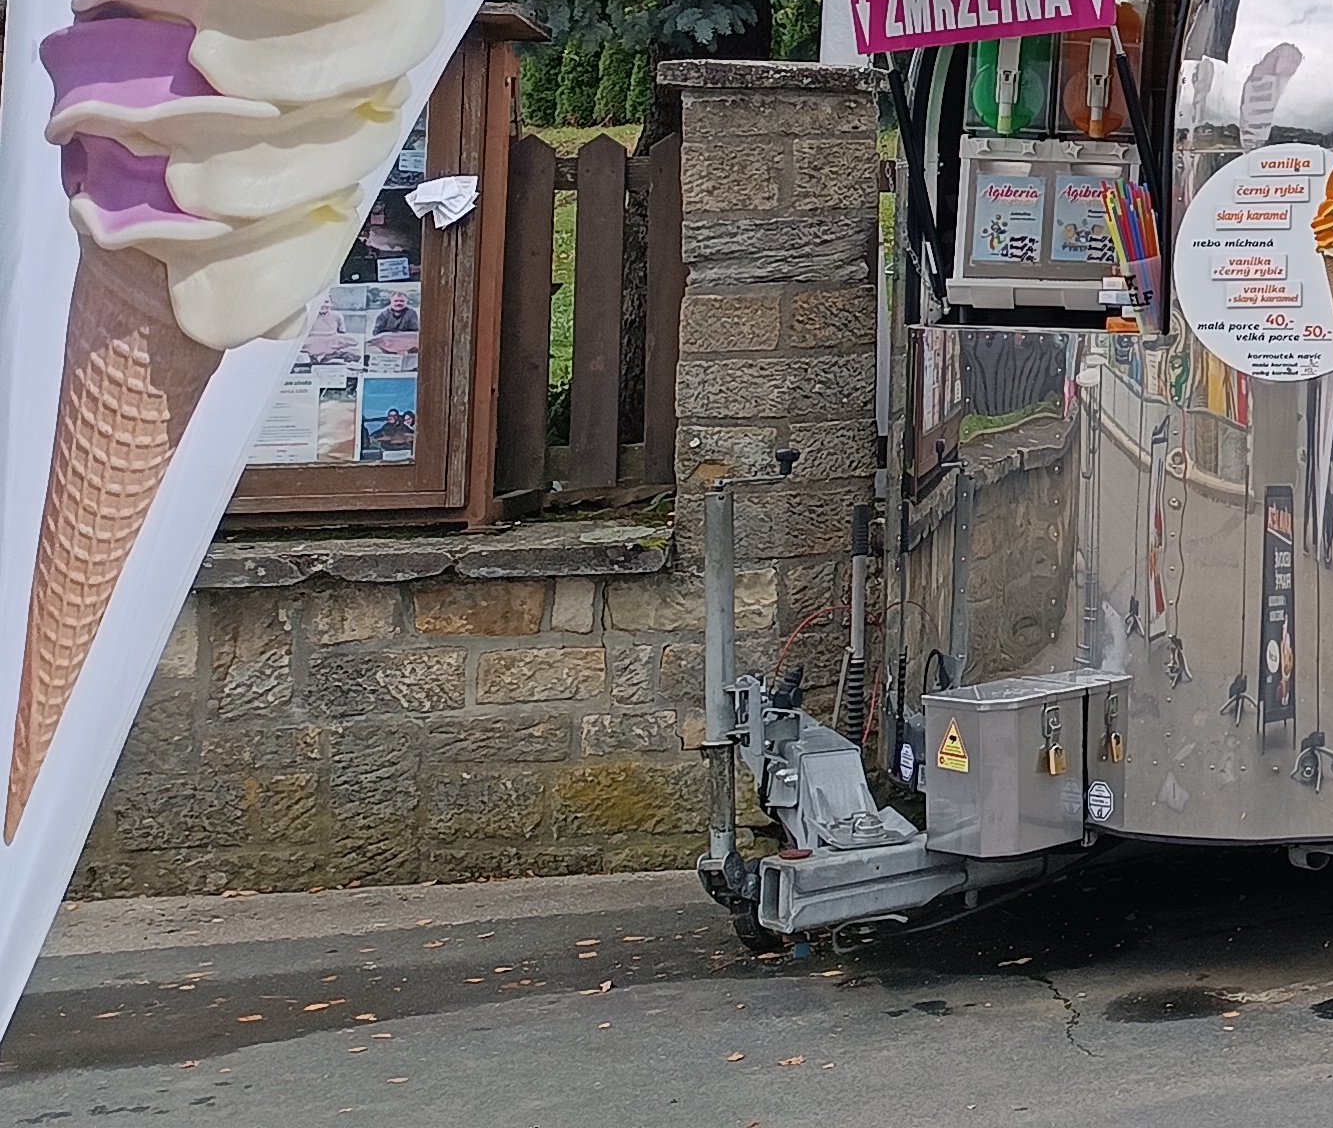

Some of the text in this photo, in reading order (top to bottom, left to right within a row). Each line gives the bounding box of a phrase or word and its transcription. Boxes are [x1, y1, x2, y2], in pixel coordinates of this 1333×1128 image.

[1260, 158, 1311, 170] vanilka
[985, 185, 1042, 202] Agiberia
[1063, 185, 1106, 202] Agiber
[1236, 183, 1306, 196] černý rybíz
[1216, 209, 1289, 224] slaný karamel
[1193, 238, 1274, 248] nebo míchaná
[1228, 257, 1272, 266] vanilka
[1254, 266, 1284, 277] rybíz
[1243, 285, 1286, 294] vanilka
[1260, 293, 1299, 303] karamel
[1197, 314, 1295, 332] malá porce 40,-
[1236, 325, 1333, 342] velká porce 50,-
